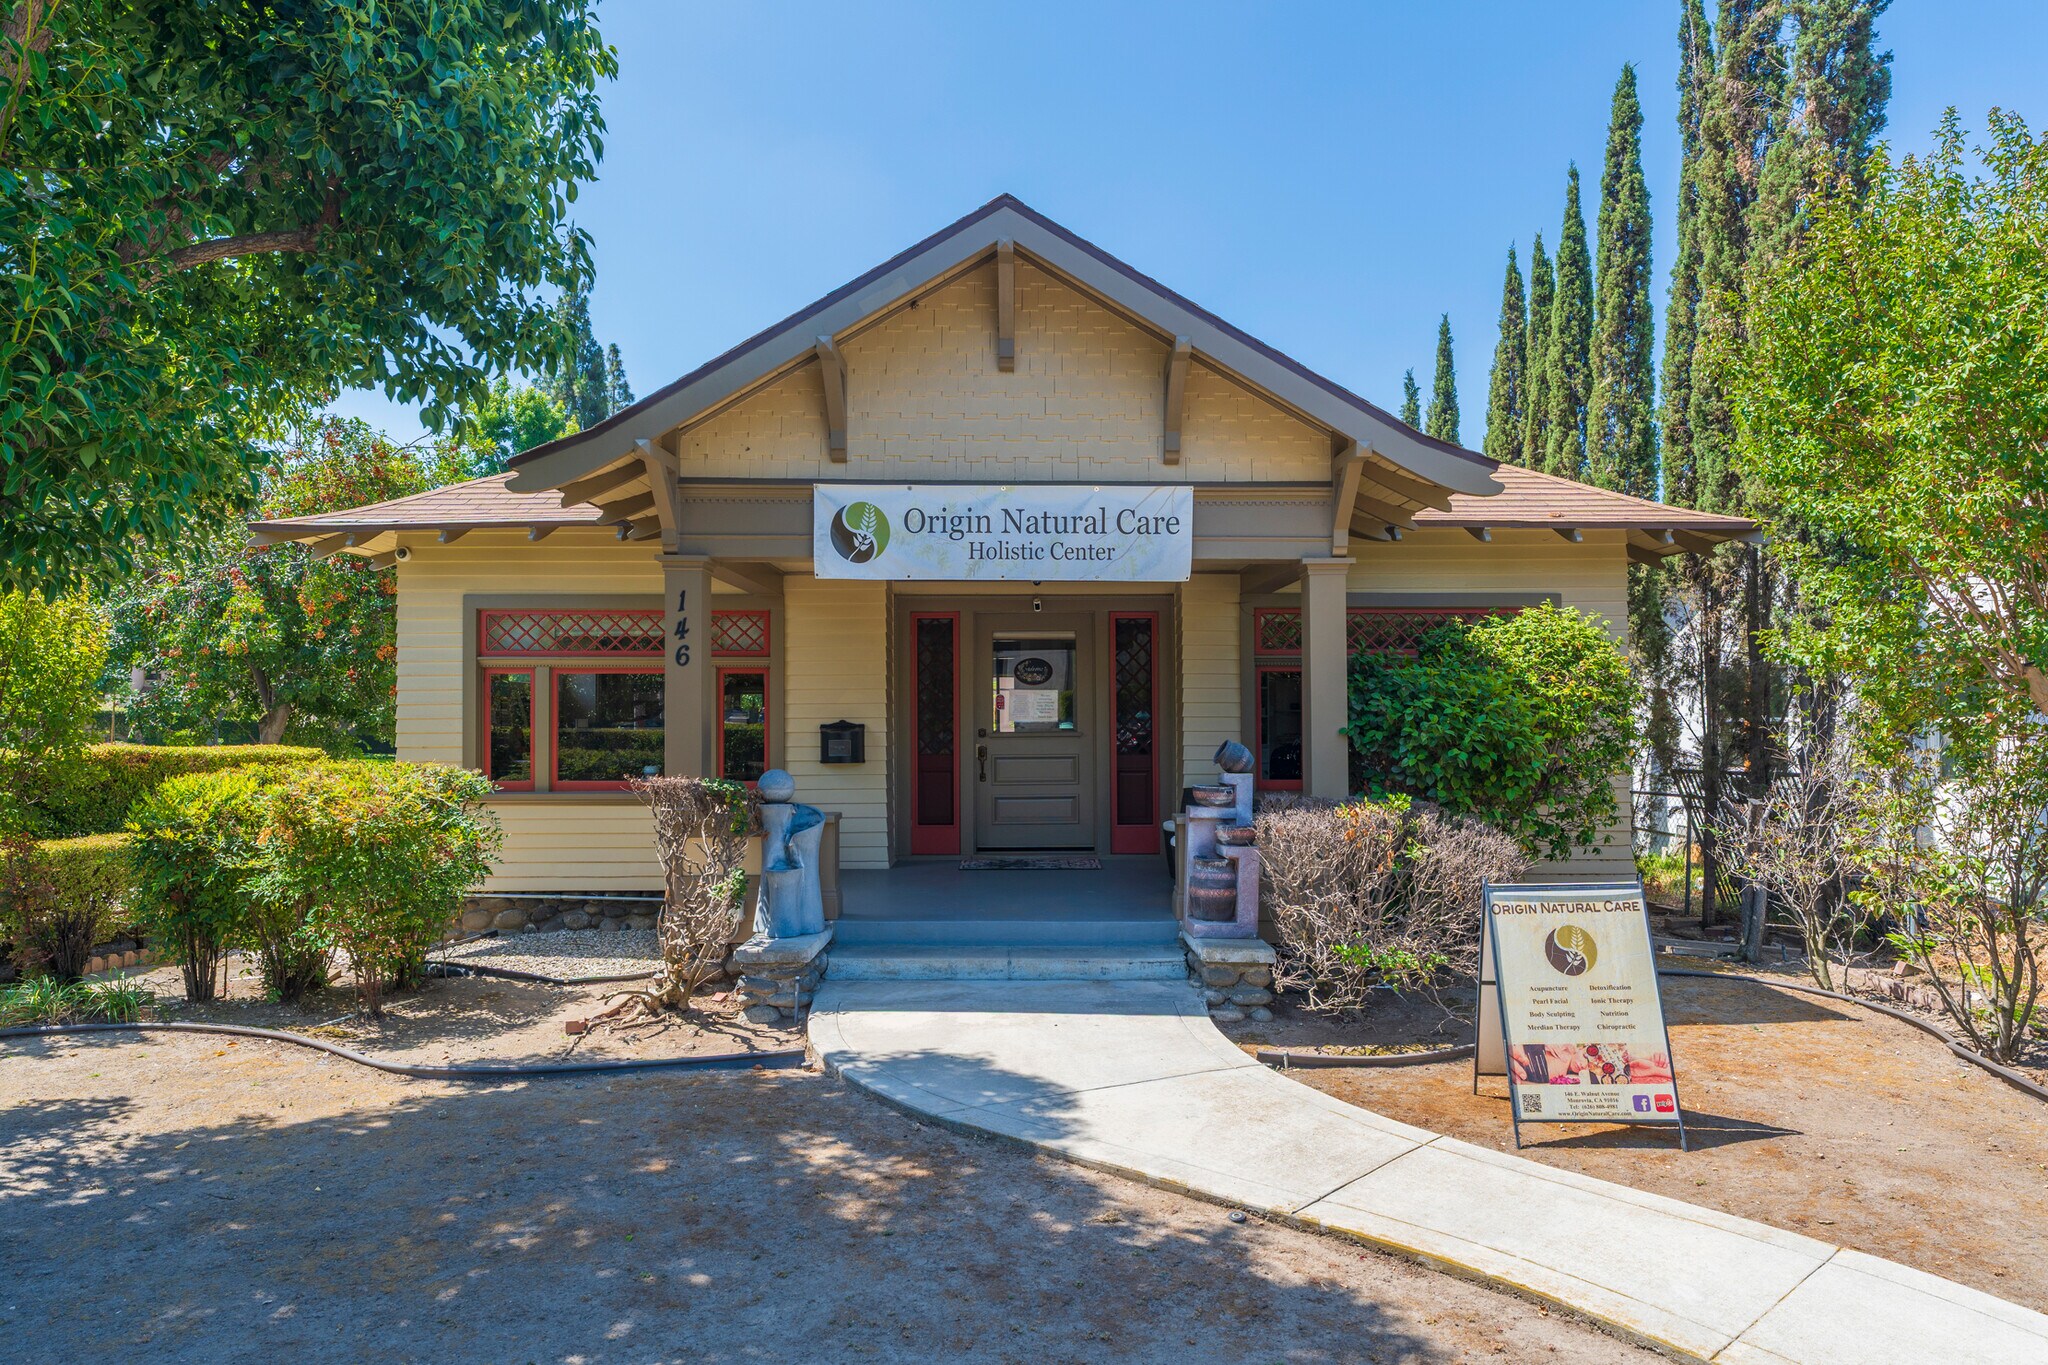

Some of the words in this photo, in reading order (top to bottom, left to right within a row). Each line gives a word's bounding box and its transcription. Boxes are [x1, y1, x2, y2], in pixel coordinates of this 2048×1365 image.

[903, 507, 993, 540] Origin
[1001, 506, 1108, 535] Natural
[1116, 508, 1181, 536] Care
[968, 541, 1045, 561] Holistic
[1050, 542, 1116, 561] Center
[674, 589, 690, 667] 146
[1491, 903, 1537, 915] ORIGIN
[1540, 902, 1600, 914] NATURAL
[1604, 900, 1640, 913] CARE
[1529, 985, 1568, 993] Acupuncture
[1608, 997, 1634, 1005] Therapy
[1597, 1023, 1636, 1031] Chiropractic
